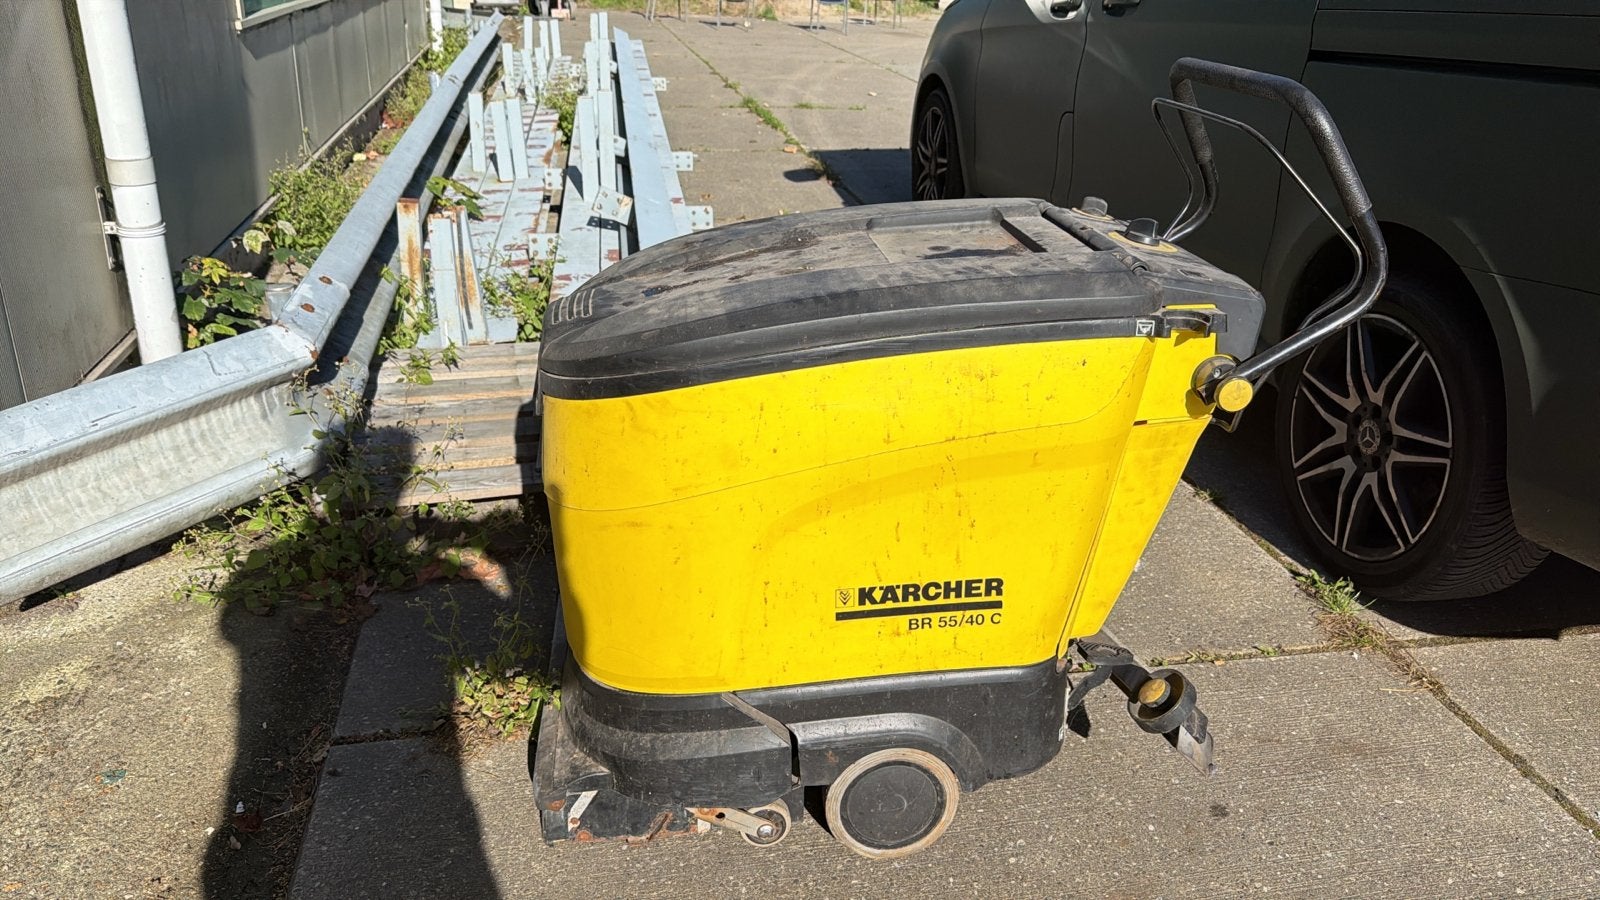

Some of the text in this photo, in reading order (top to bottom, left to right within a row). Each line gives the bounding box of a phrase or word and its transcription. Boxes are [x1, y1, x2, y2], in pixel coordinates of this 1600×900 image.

[858, 578, 1003, 606] KÄRCHER
[908, 613, 1002, 631] BR 55/40 C
